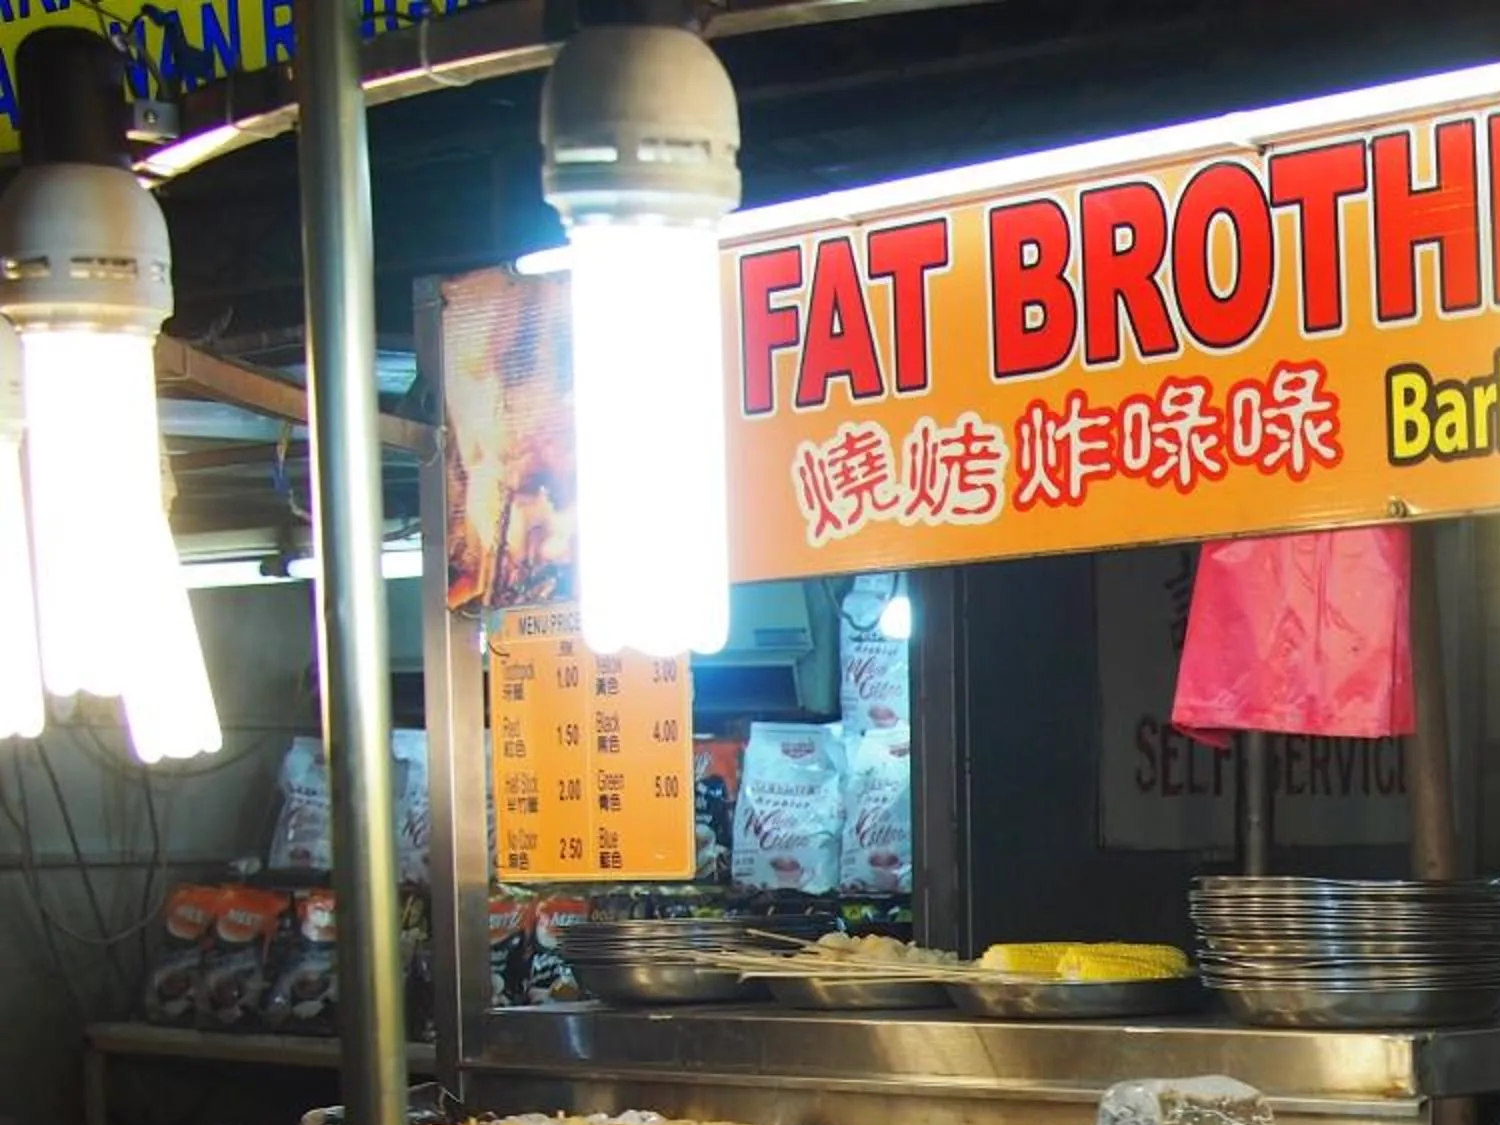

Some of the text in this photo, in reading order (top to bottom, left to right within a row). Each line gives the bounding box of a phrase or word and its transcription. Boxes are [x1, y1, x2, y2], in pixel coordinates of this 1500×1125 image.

[739, 218, 949, 415] FAT
[518, 614, 546, 635] MENU
[556, 666, 579, 689] 1.00
[556, 724, 580, 746] 1.50
[653, 720, 678, 743] 4.00
[1268, 733, 1407, 799] ERVIC
[559, 779, 582, 801] 2.00
[655, 775, 679, 798] 5.00
[560, 837, 582, 860] 2.50
